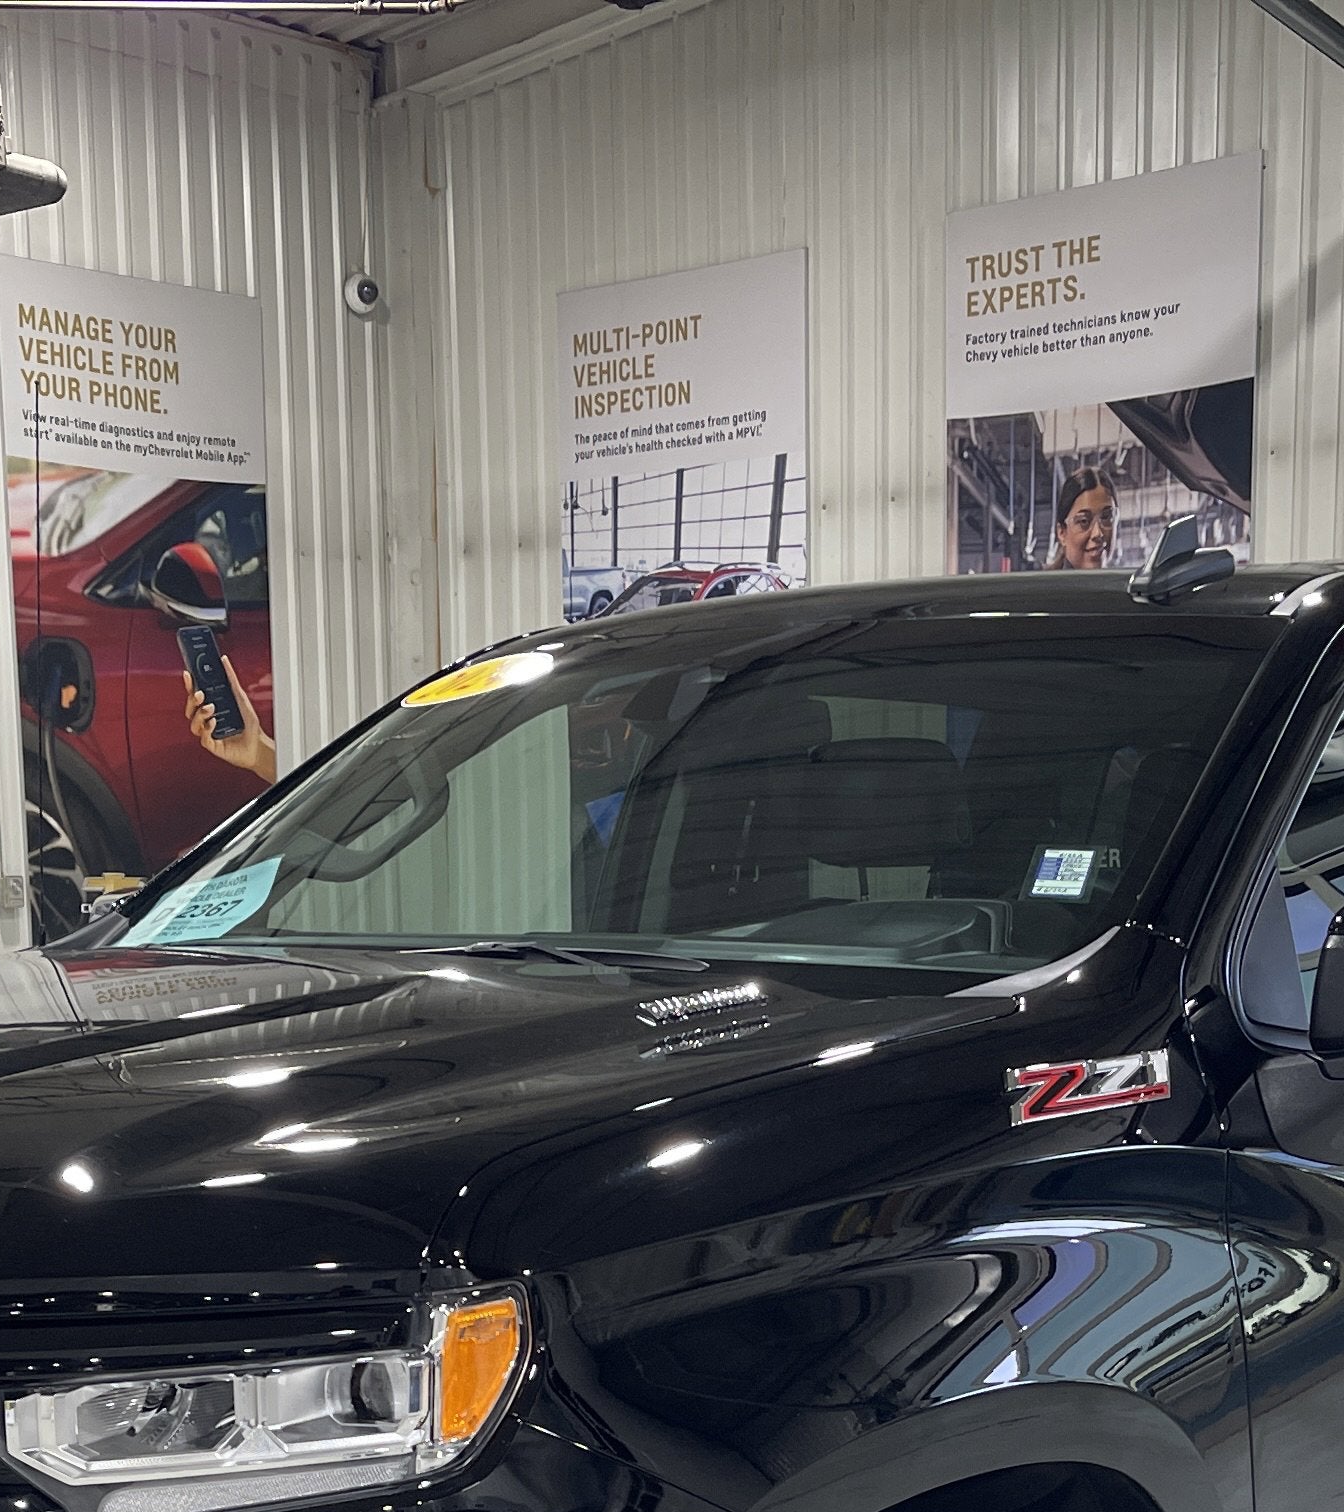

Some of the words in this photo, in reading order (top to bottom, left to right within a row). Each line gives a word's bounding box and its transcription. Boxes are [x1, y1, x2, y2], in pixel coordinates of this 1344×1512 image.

[966, 245, 1045, 283] TRUST
[1052, 234, 1101, 269] THE
[967, 275, 1086, 317] EXPERTS.
[18, 303, 113, 345] MANAGE
[119, 320, 177, 354] YOUR
[573, 314, 702, 357] MULTI-POINT
[965, 330, 1007, 346] Factory
[1009, 322, 1050, 341] trained
[1053, 313, 1117, 335] technicians
[1120, 307, 1150, 323] know
[1153, 302, 1181, 320] your
[19, 335, 114, 375] VEHICLE
[121, 353, 179, 385] FROM
[965, 349, 998, 363] Chevy
[1001, 342, 1039, 359] vehicle
[1042, 337, 1077, 354] better
[1080, 334, 1106, 348] than
[1108, 327, 1154, 346] anyone.
[20, 367, 81, 403] YOUR
[89, 380, 168, 415] PHONE.
[573, 354, 655, 388] VEHICLE
[575, 380, 691, 419] INSPECTION
[49, 415, 96, 432] real-time
[99, 421, 154, 439] diagnostics
[157, 430, 174, 442] and
[176, 432, 201, 447] enjoy
[203, 437, 236, 448] remote
[55, 432, 98, 448] available
[101, 439, 113, 449] on
[116, 440, 131, 452] the
[134, 443, 193, 460] myChevrolet
[196, 449, 224, 462] Mobile
[575, 433, 590, 445] The
[592, 430, 618, 447] peace
[620, 427, 629, 440] of
[631, 423, 652, 439] mind
[655, 422, 674, 435] that
[676, 419, 705, 434] comes
[707, 415, 730, 428] from
[732, 409, 767, 427] getting
[575, 449, 593, 464] your
[596, 442, 633, 459] vehicle's
[635, 439, 663, 454] health
[665, 434, 703, 449] checked
[705, 430, 726, 443] with
[728, 432, 734, 440] a
